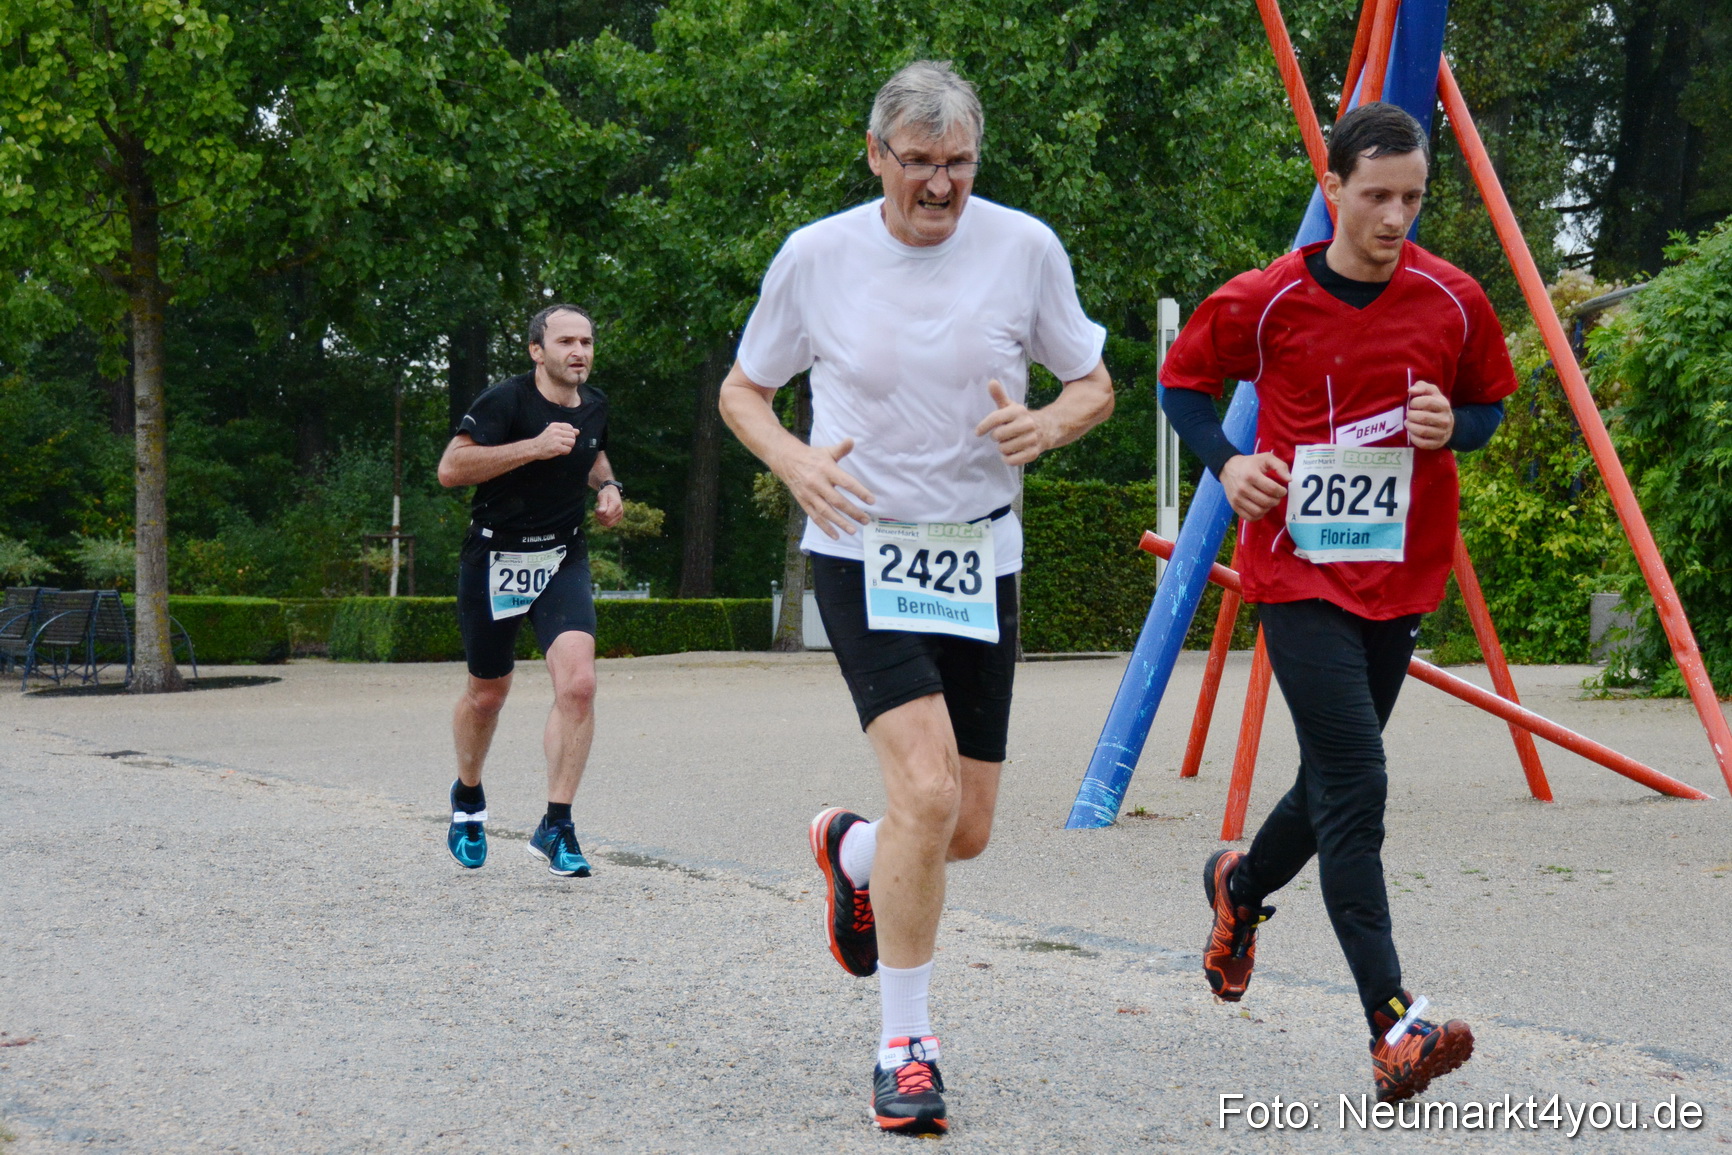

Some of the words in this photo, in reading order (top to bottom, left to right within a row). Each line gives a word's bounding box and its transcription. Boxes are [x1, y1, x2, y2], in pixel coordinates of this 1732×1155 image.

[1356, 421, 1387, 439] DEHN
[1343, 450, 1402, 465] BOCK
[1300, 473, 1398, 516] 2624
[875, 527, 919, 538] NeuerMarkt
[1320, 528, 1371, 546] Florian
[879, 543, 982, 596] 2423
[897, 596, 970, 623] Bernhard
